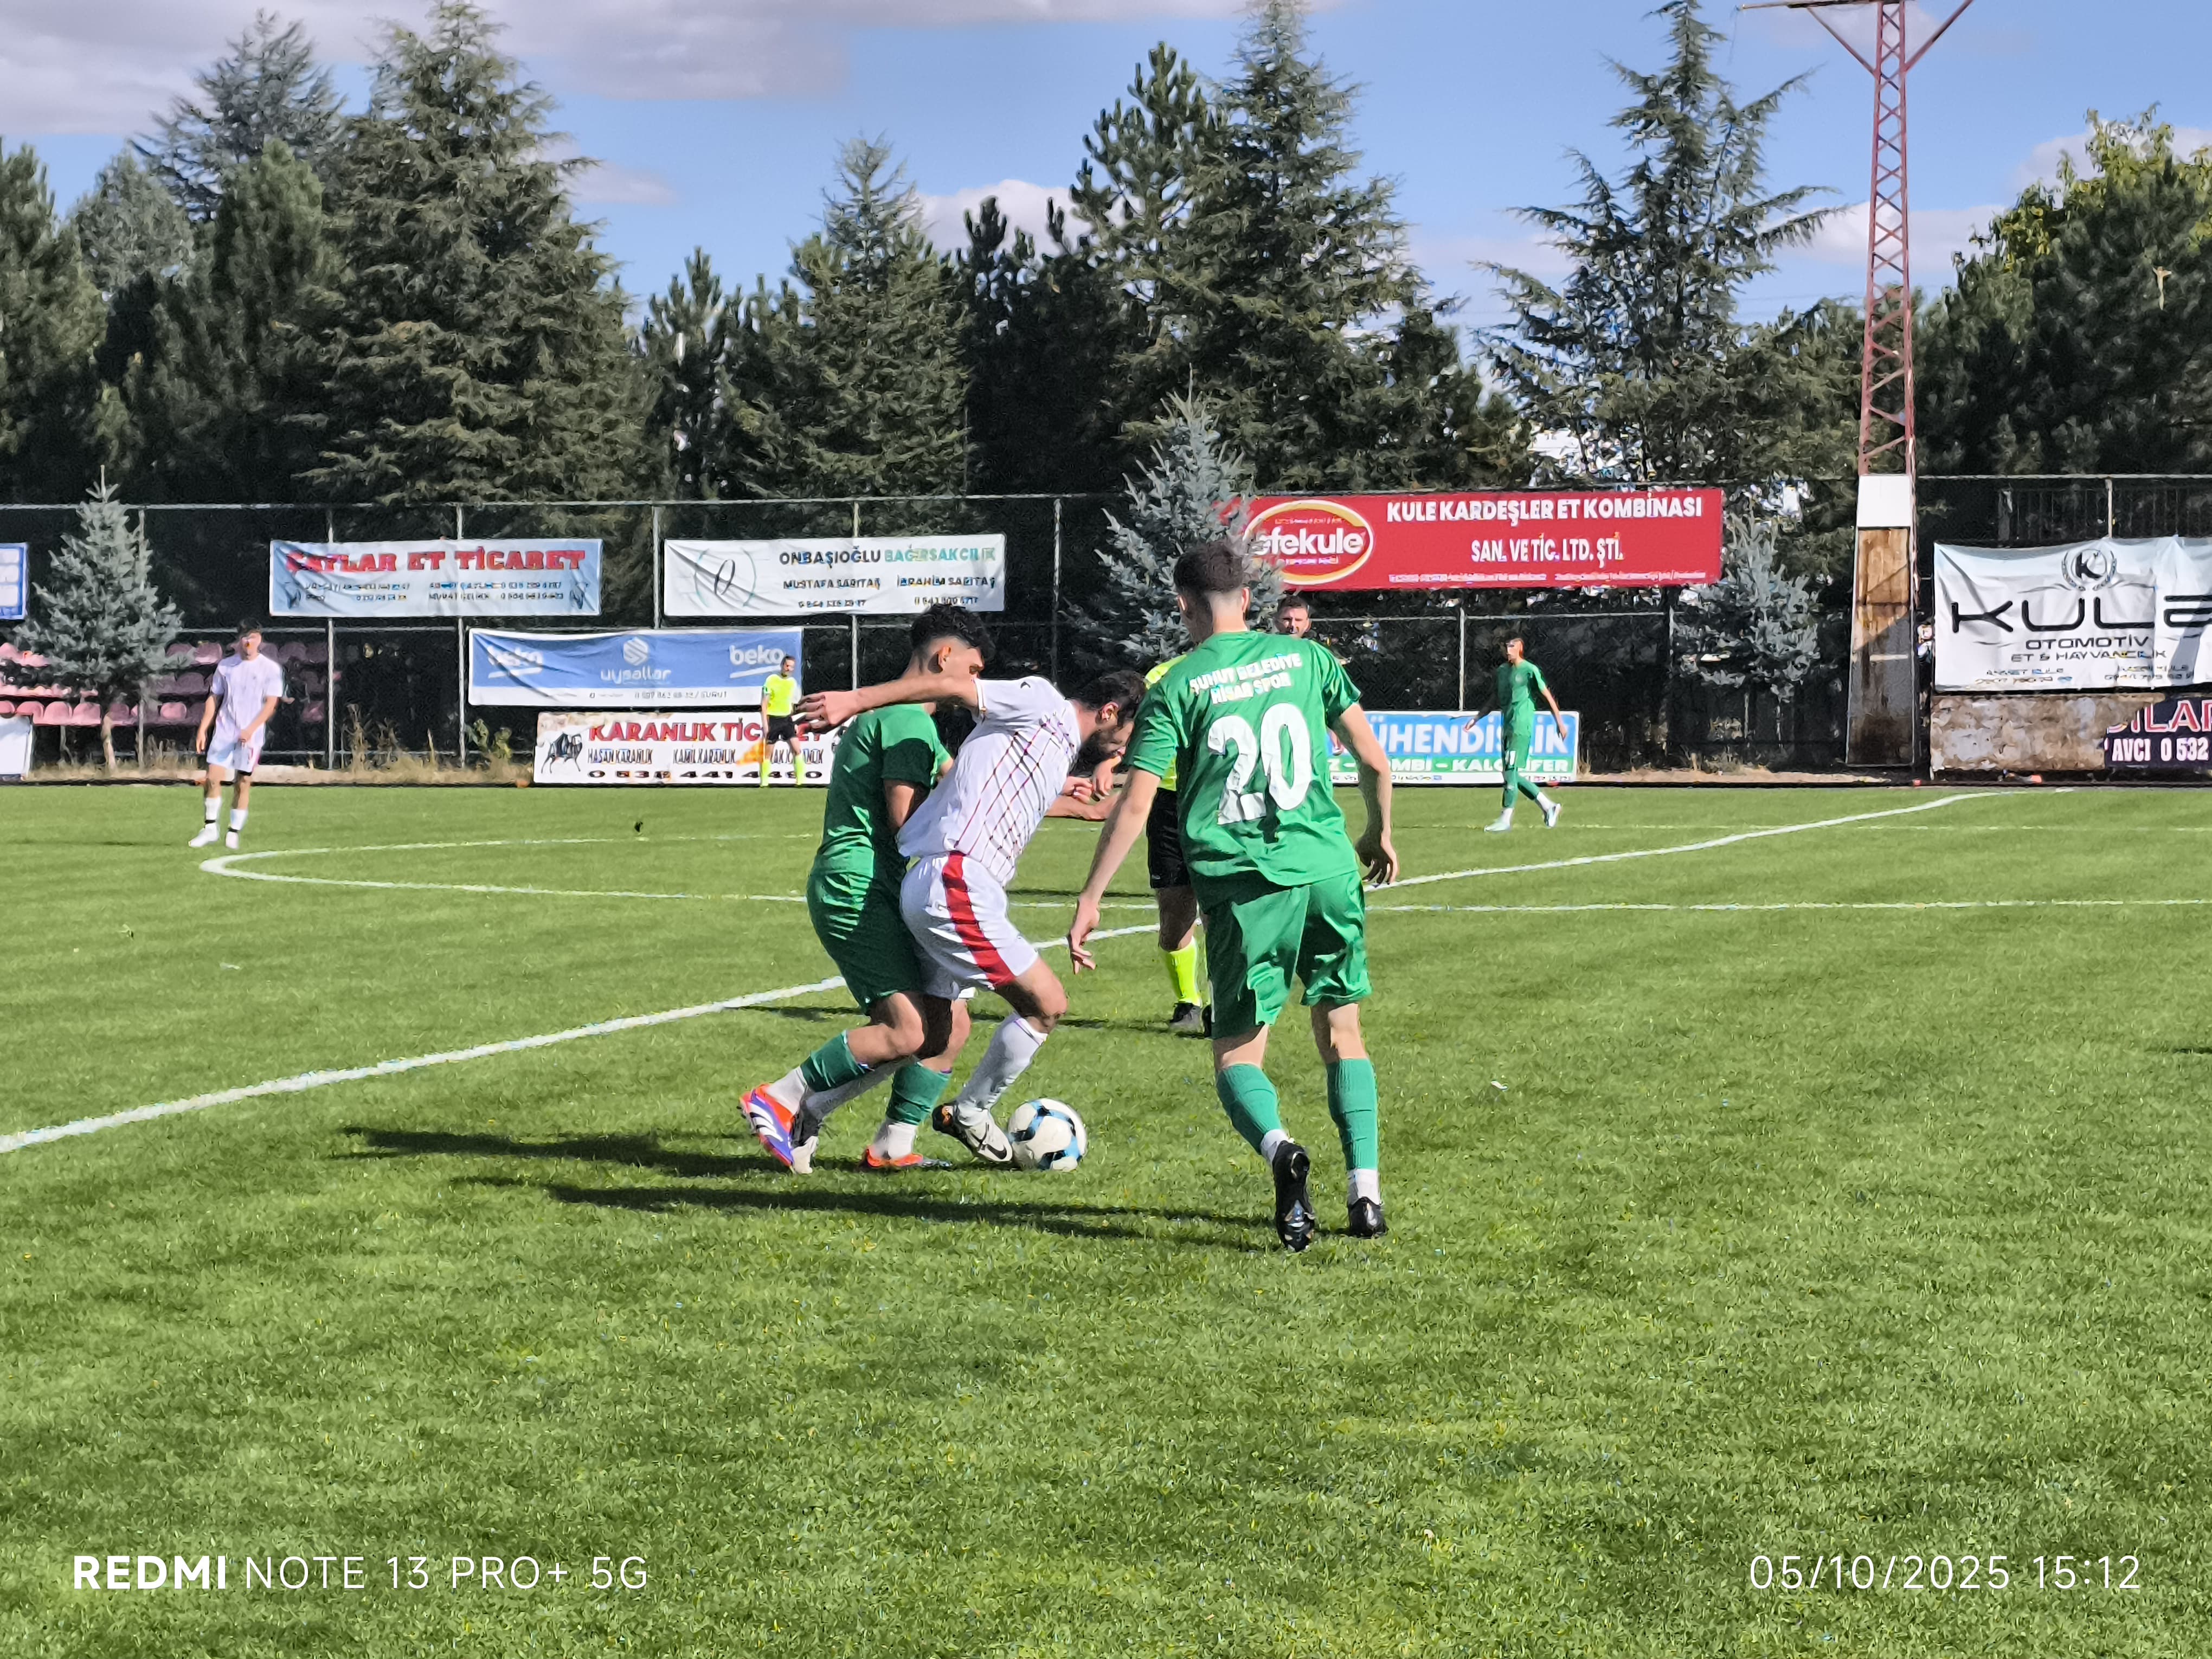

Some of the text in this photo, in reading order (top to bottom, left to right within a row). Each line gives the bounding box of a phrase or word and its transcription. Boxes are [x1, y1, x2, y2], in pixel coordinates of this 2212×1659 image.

[1387, 492, 1702, 527] KULE KARDEŞLER ET KOMBİNASI
[408, 551, 445, 571] ET
[455, 545, 585, 570] TİCARET
[779, 545, 881, 569] ONBAŞIOĞLU
[1471, 532, 1625, 568] SAN. VE TİC. LTD. ŞTİ.
[2025, 634, 2149, 650] OTOMOTİV
[729, 644, 785, 665] beko
[2011, 653, 2035, 662] ET
[1253, 672, 1292, 695] SPOR
[589, 722, 717, 742] KARANLIK
[1369, 715, 1569, 754] ÜHENDİİK
[2112, 737, 2209, 762] AVCI 0 532
[1208, 703, 1312, 825] 20
[1389, 756, 1432, 772] MBİ
